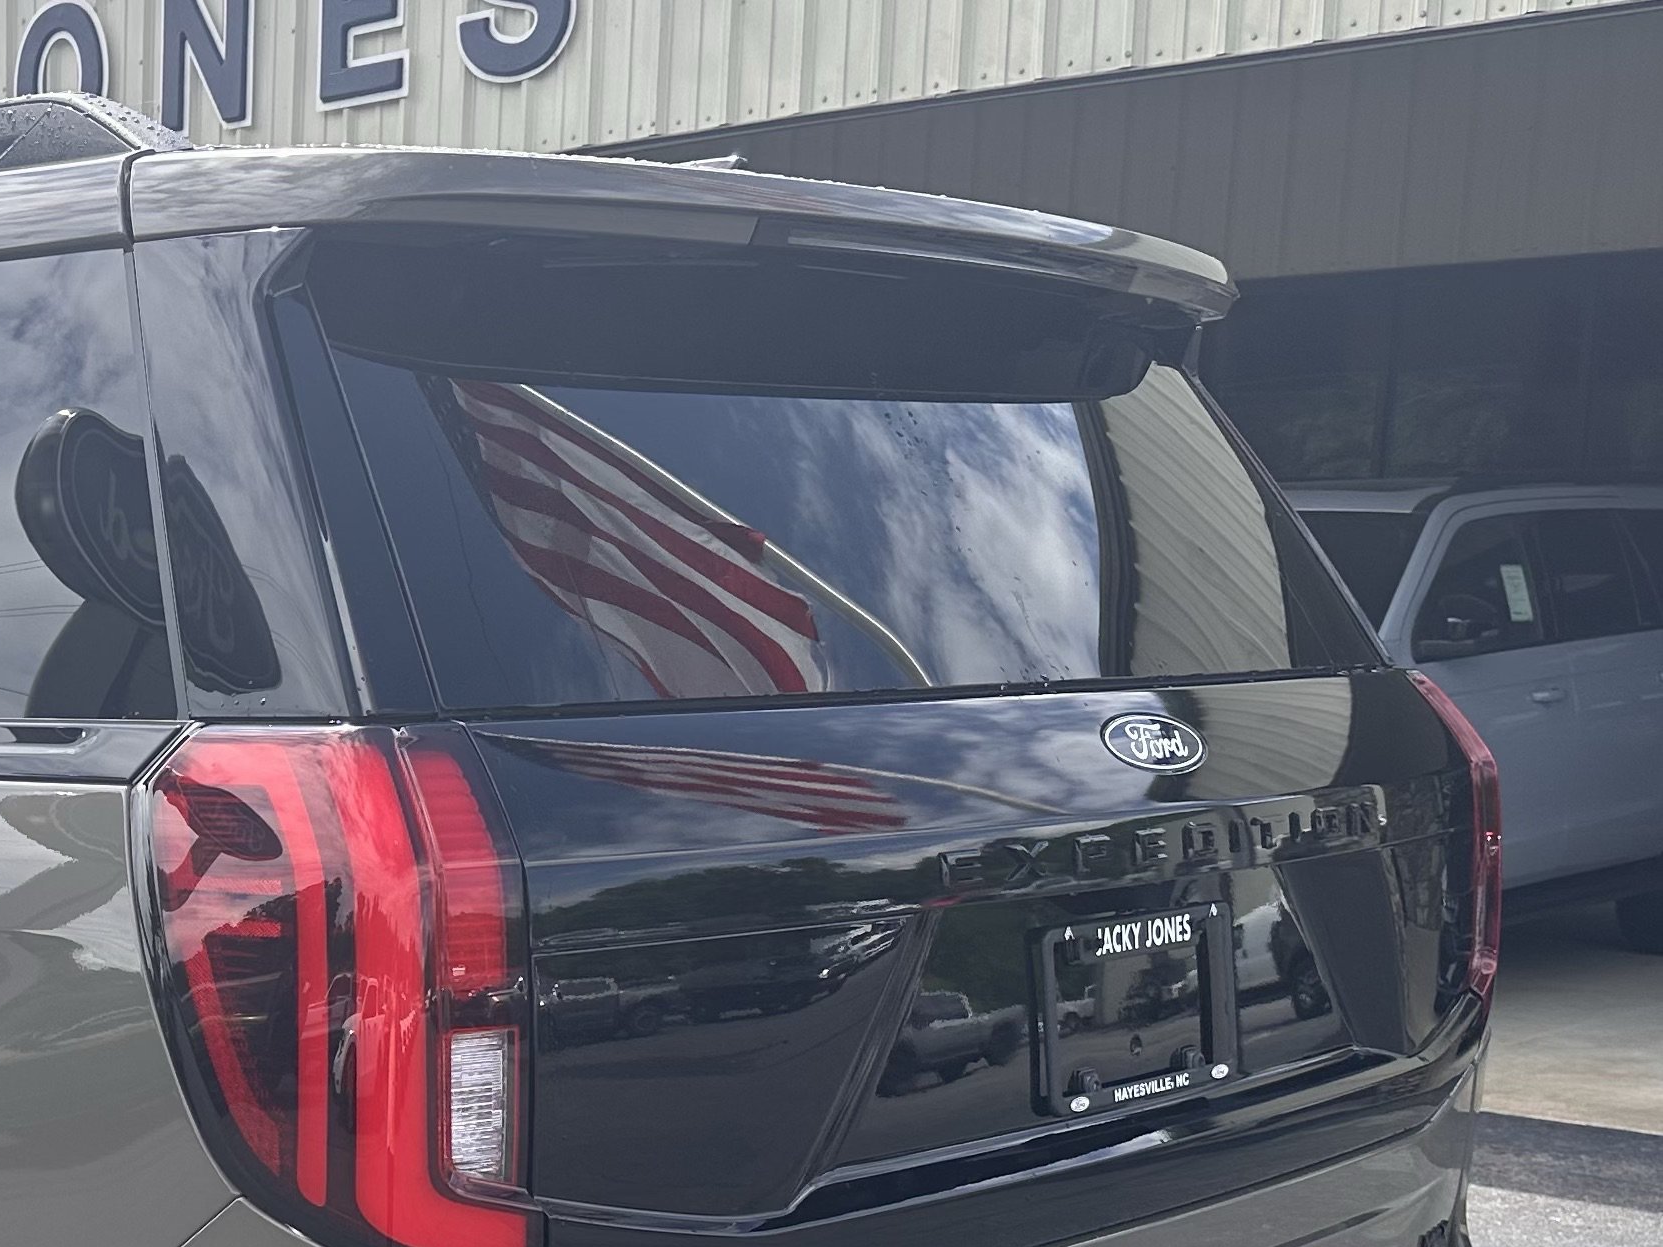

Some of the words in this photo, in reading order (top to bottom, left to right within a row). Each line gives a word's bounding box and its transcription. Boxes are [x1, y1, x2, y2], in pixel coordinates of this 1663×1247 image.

[1124, 723, 1189, 760] Ford
[1145, 913, 1192, 948] JONES
[1176, 1073, 1190, 1087] NC
